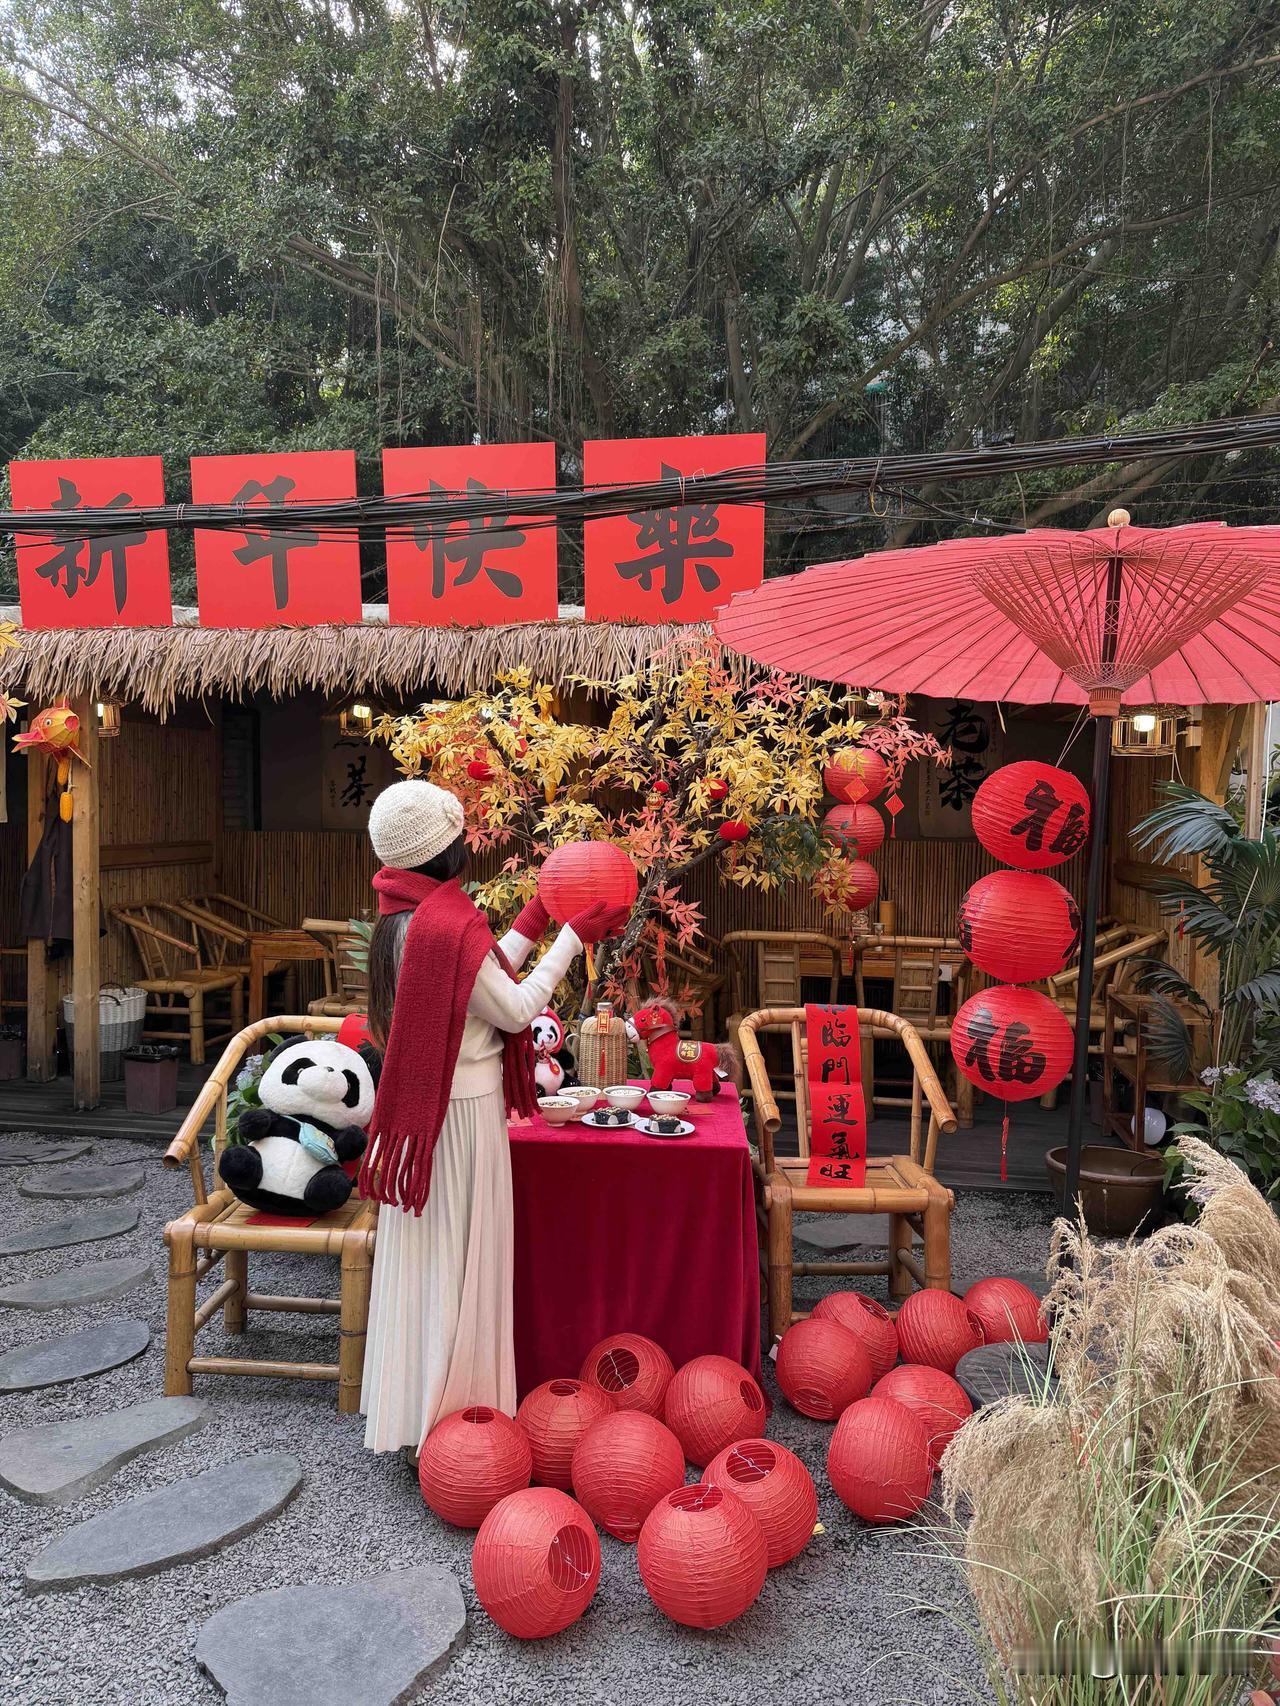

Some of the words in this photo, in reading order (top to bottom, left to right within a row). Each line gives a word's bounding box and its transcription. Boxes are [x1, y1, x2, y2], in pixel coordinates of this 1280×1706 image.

[35, 462, 734, 615] 新年快樂
[1010, 779, 1089, 856] 福
[964, 1008, 1047, 1084] 福
